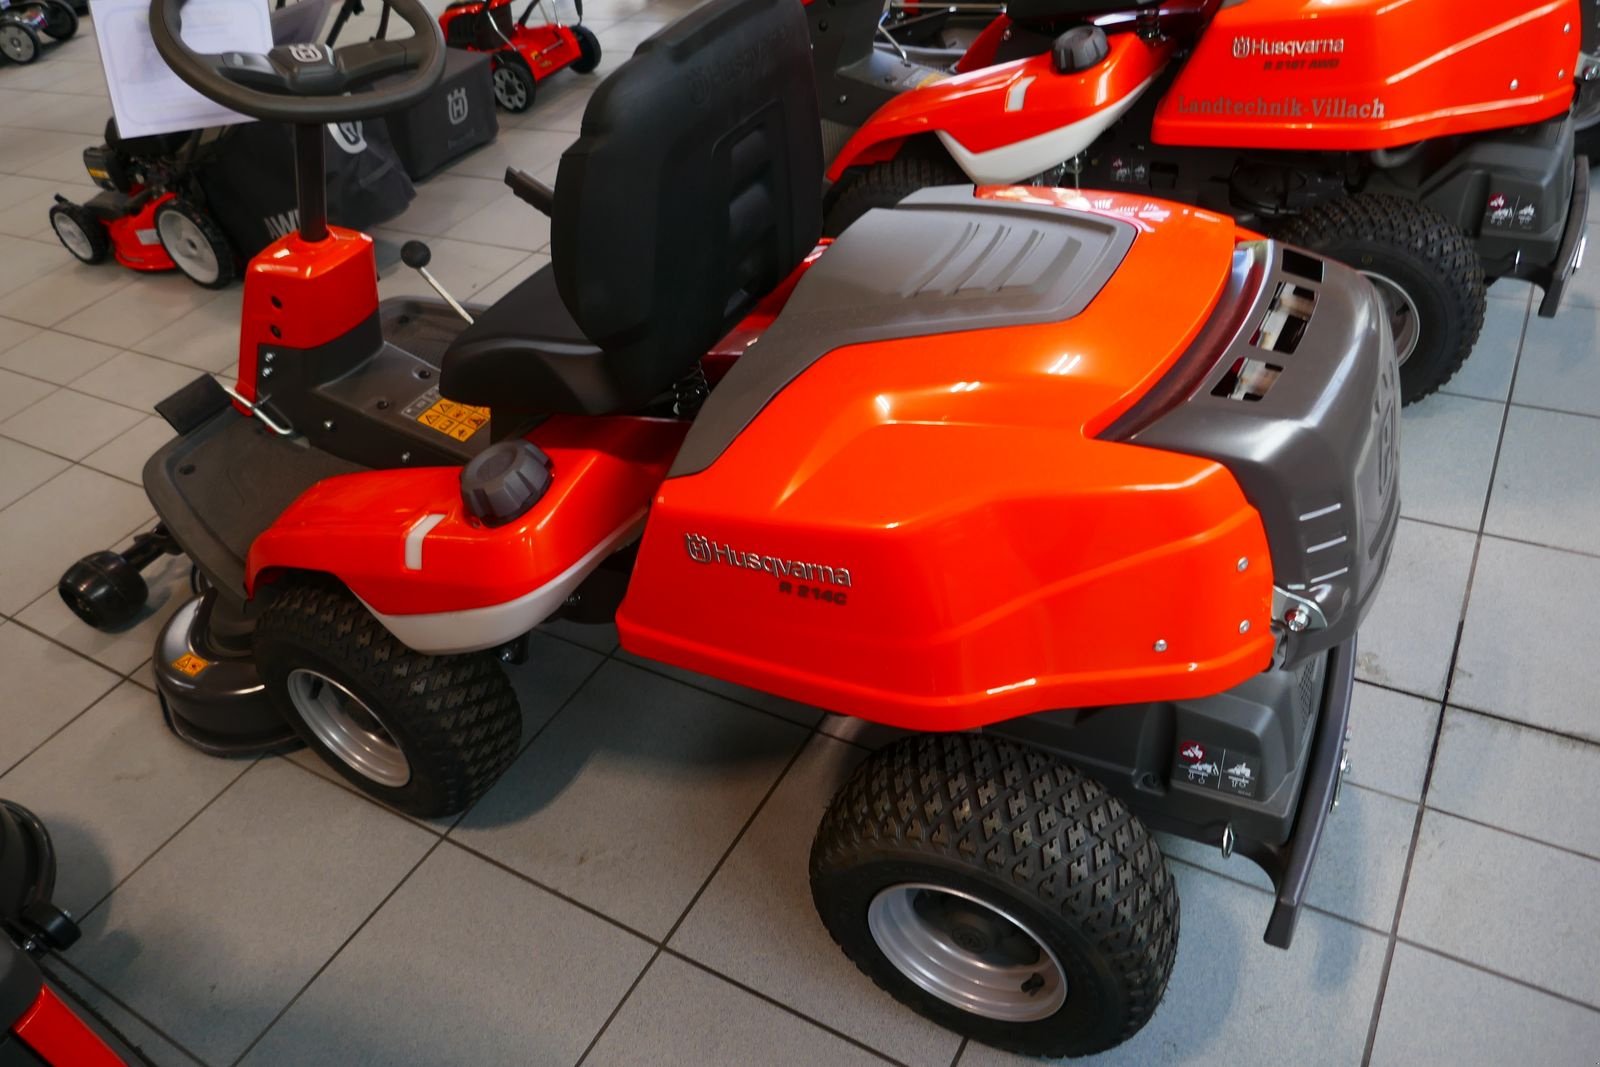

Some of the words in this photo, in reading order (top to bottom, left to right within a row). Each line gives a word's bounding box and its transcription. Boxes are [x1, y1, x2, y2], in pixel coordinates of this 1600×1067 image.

[1251, 38, 1344, 57] Husqvarna
[1178, 95, 1386, 119] Landtechnik-Villach
[711, 541, 852, 587] Husqvarna
[779, 581, 792, 594] R
[797, 585, 847, 606] 214C
